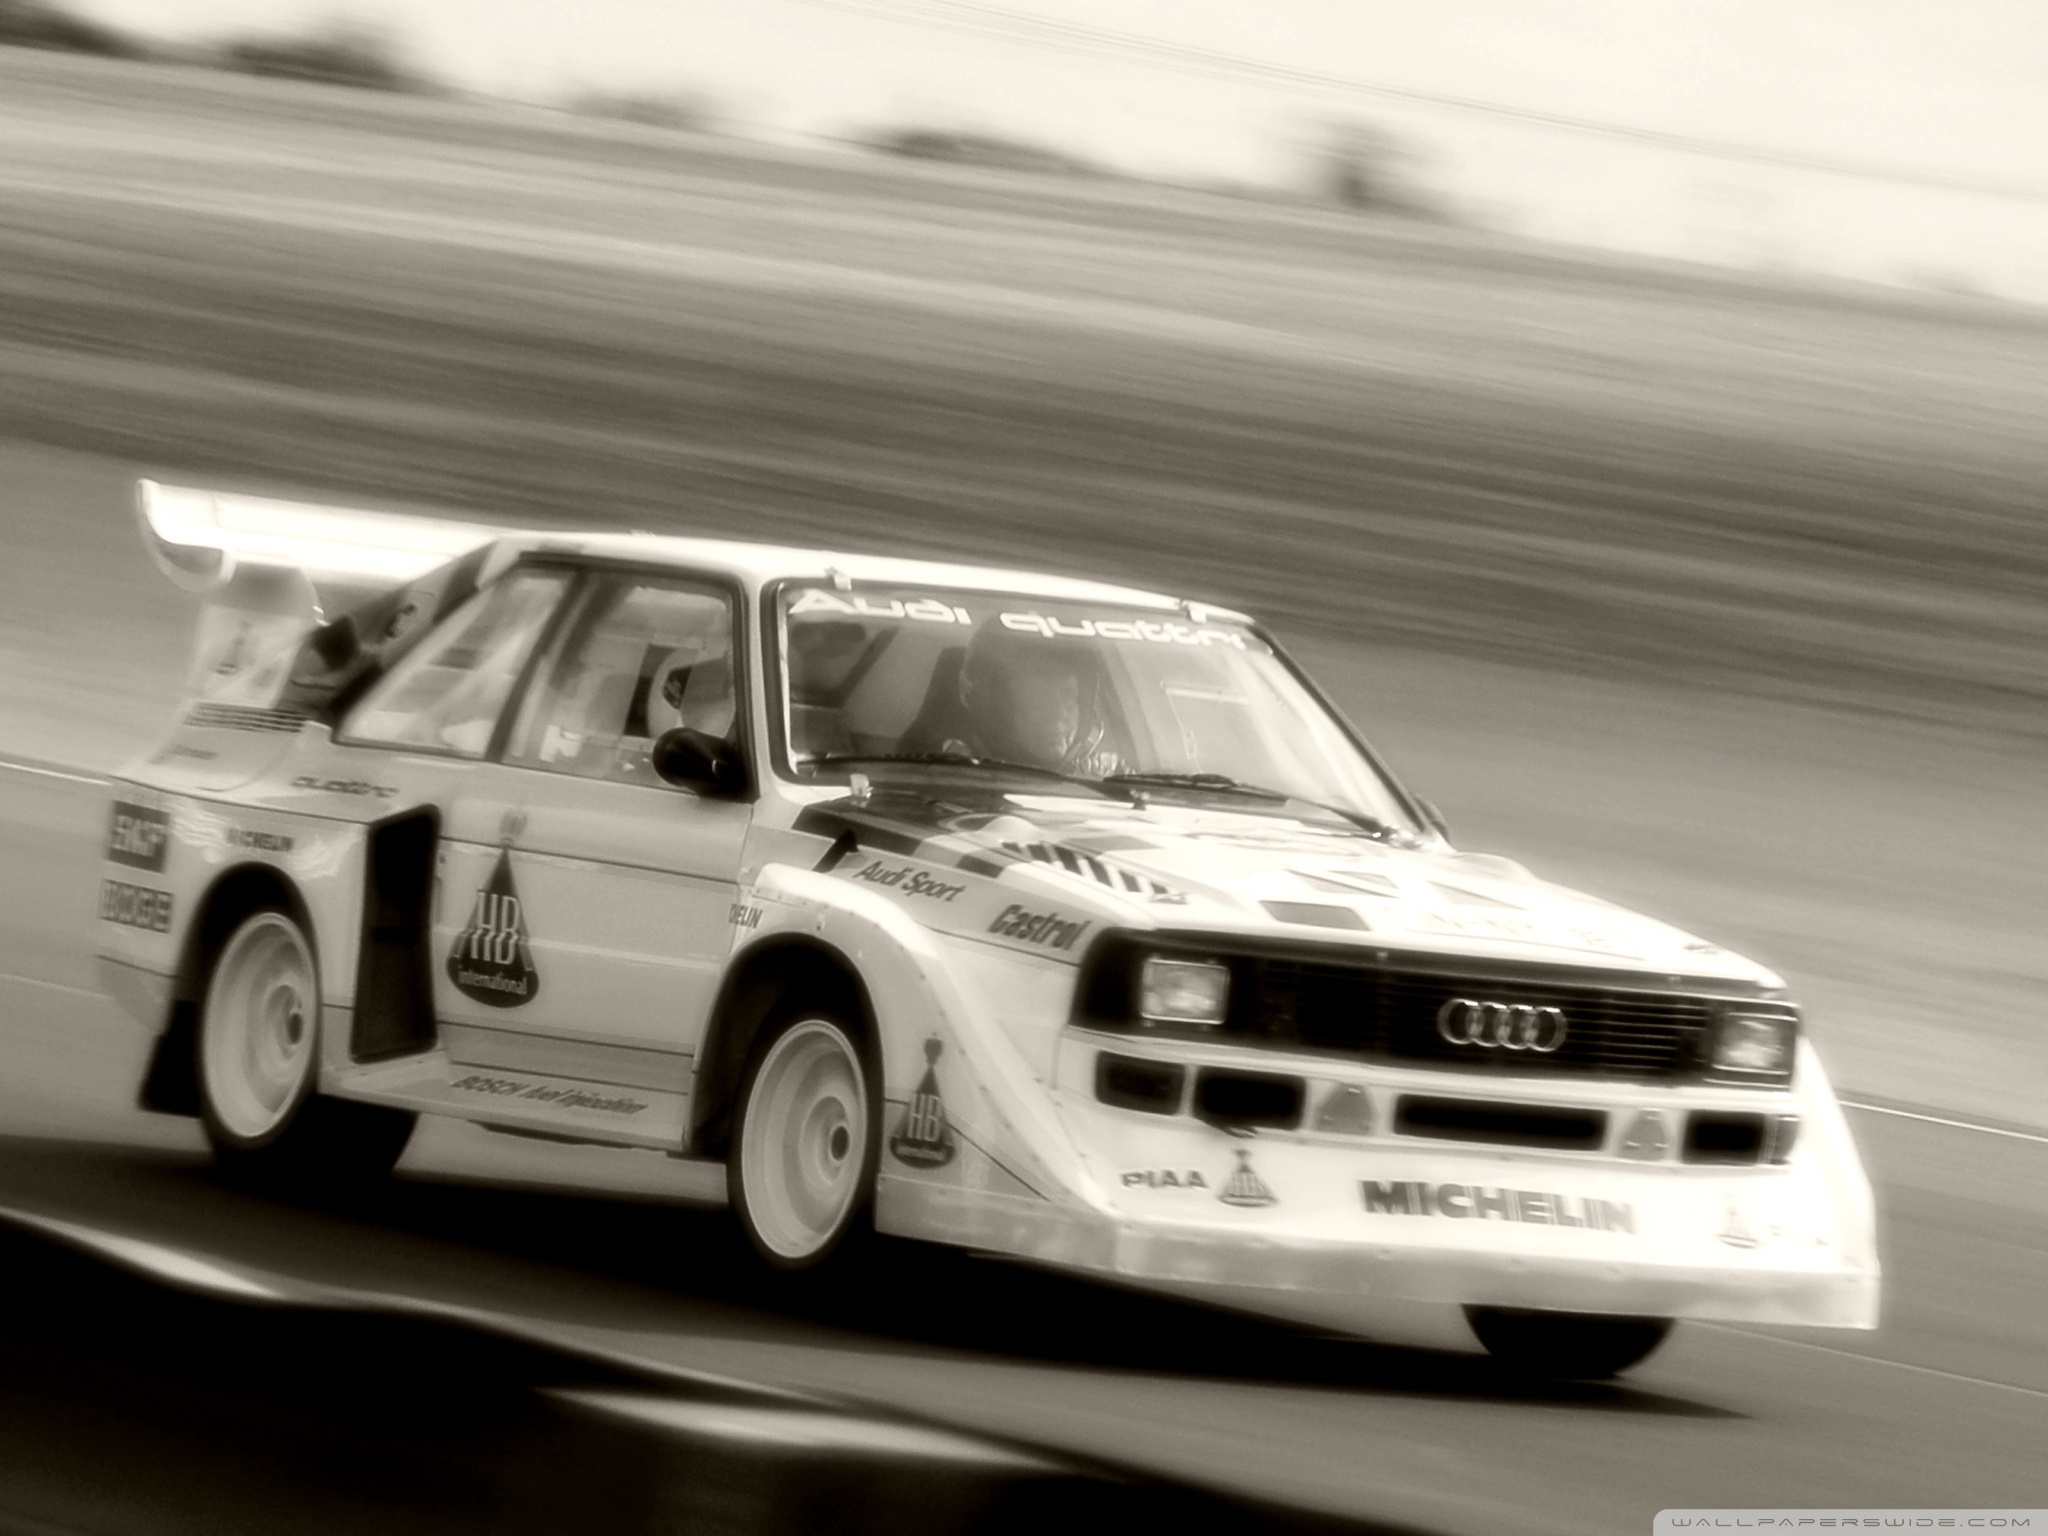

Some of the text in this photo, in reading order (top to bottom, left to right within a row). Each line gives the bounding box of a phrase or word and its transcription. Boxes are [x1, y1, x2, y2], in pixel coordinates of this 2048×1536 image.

[853, 860, 967, 901] Audi Sport
[987, 904, 1093, 950] Castrol
[1119, 1169, 1210, 1189] PIAA
[1358, 1179, 1637, 1236] MICHELIN
